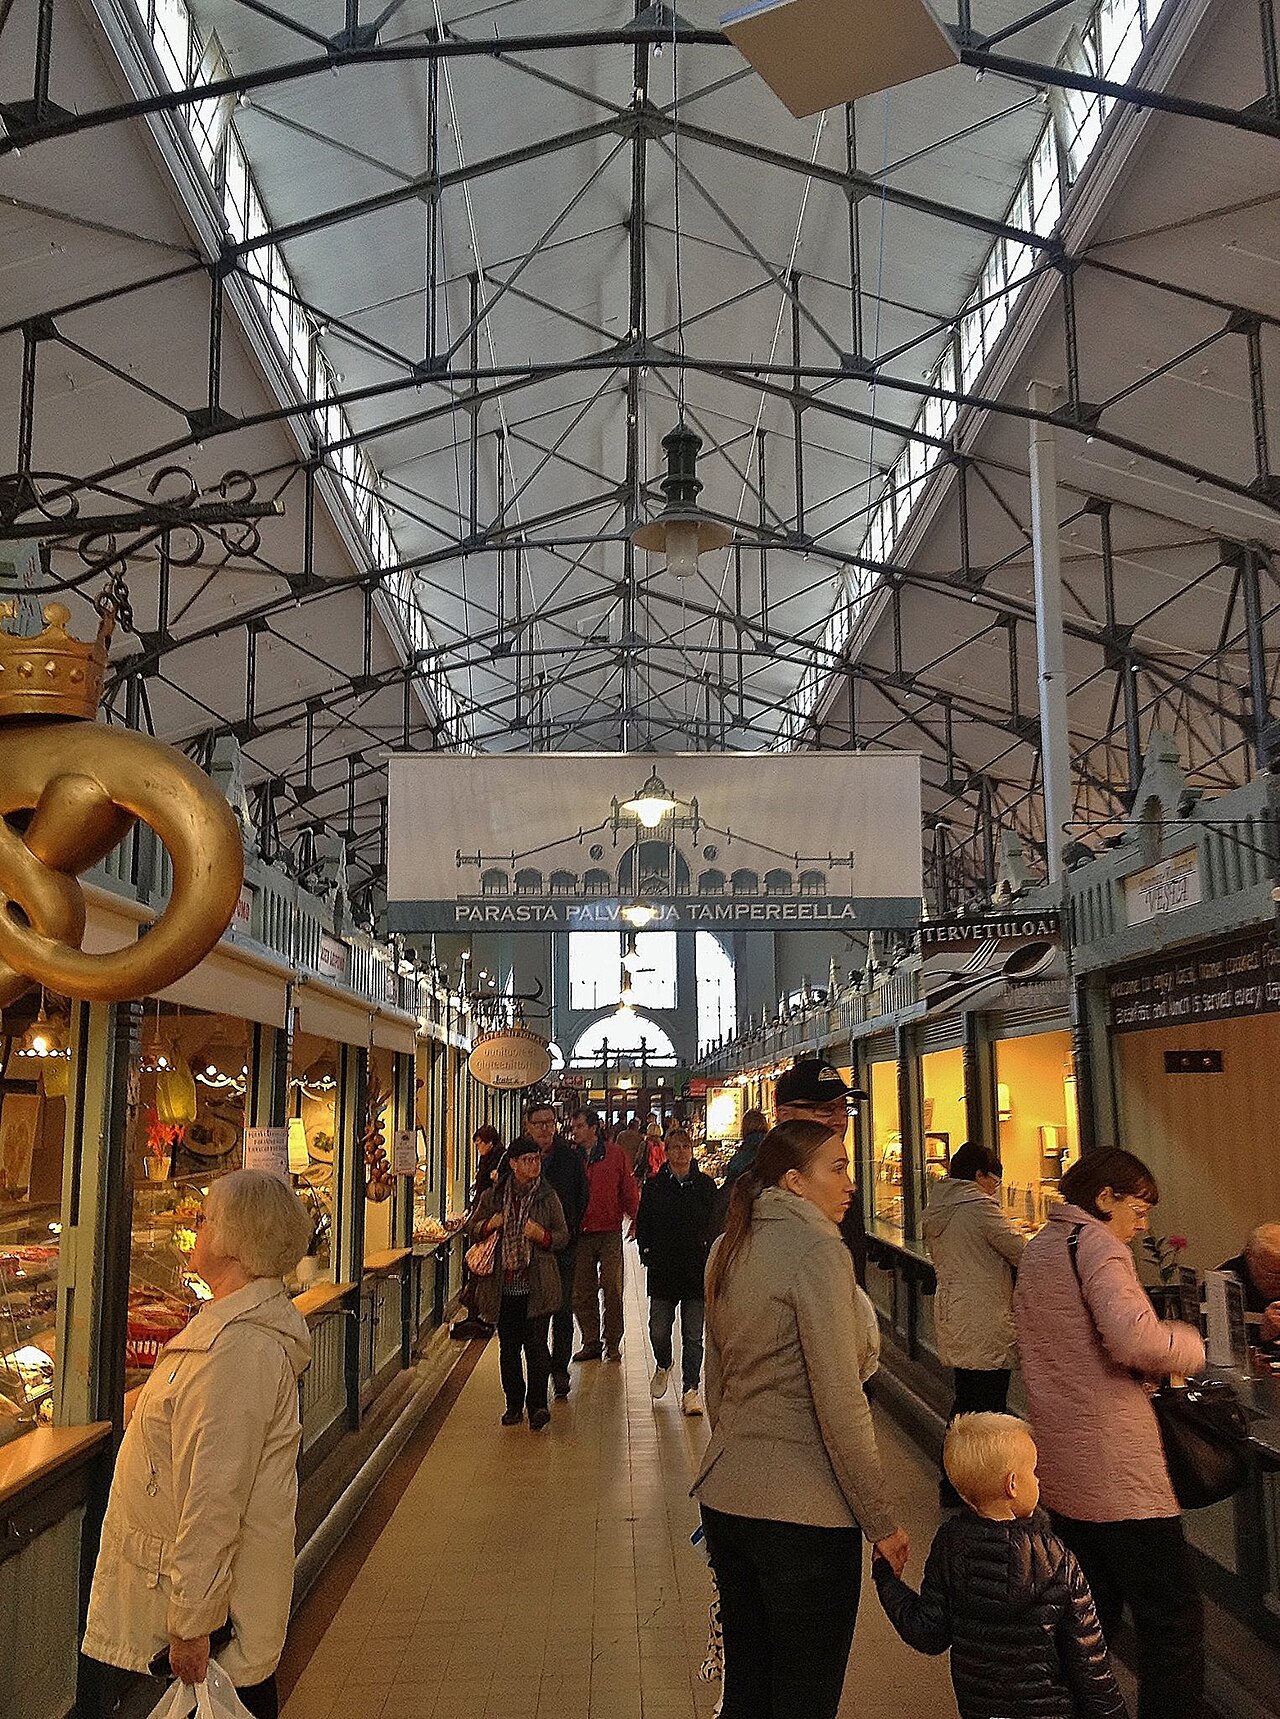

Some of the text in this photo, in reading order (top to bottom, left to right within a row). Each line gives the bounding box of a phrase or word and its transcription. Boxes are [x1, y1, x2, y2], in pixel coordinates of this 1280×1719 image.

[454, 904, 558, 922] PARASTA
[686, 902, 857, 921] TAMPEREELLA
[923, 920, 1056, 942] TERVETULOA!
